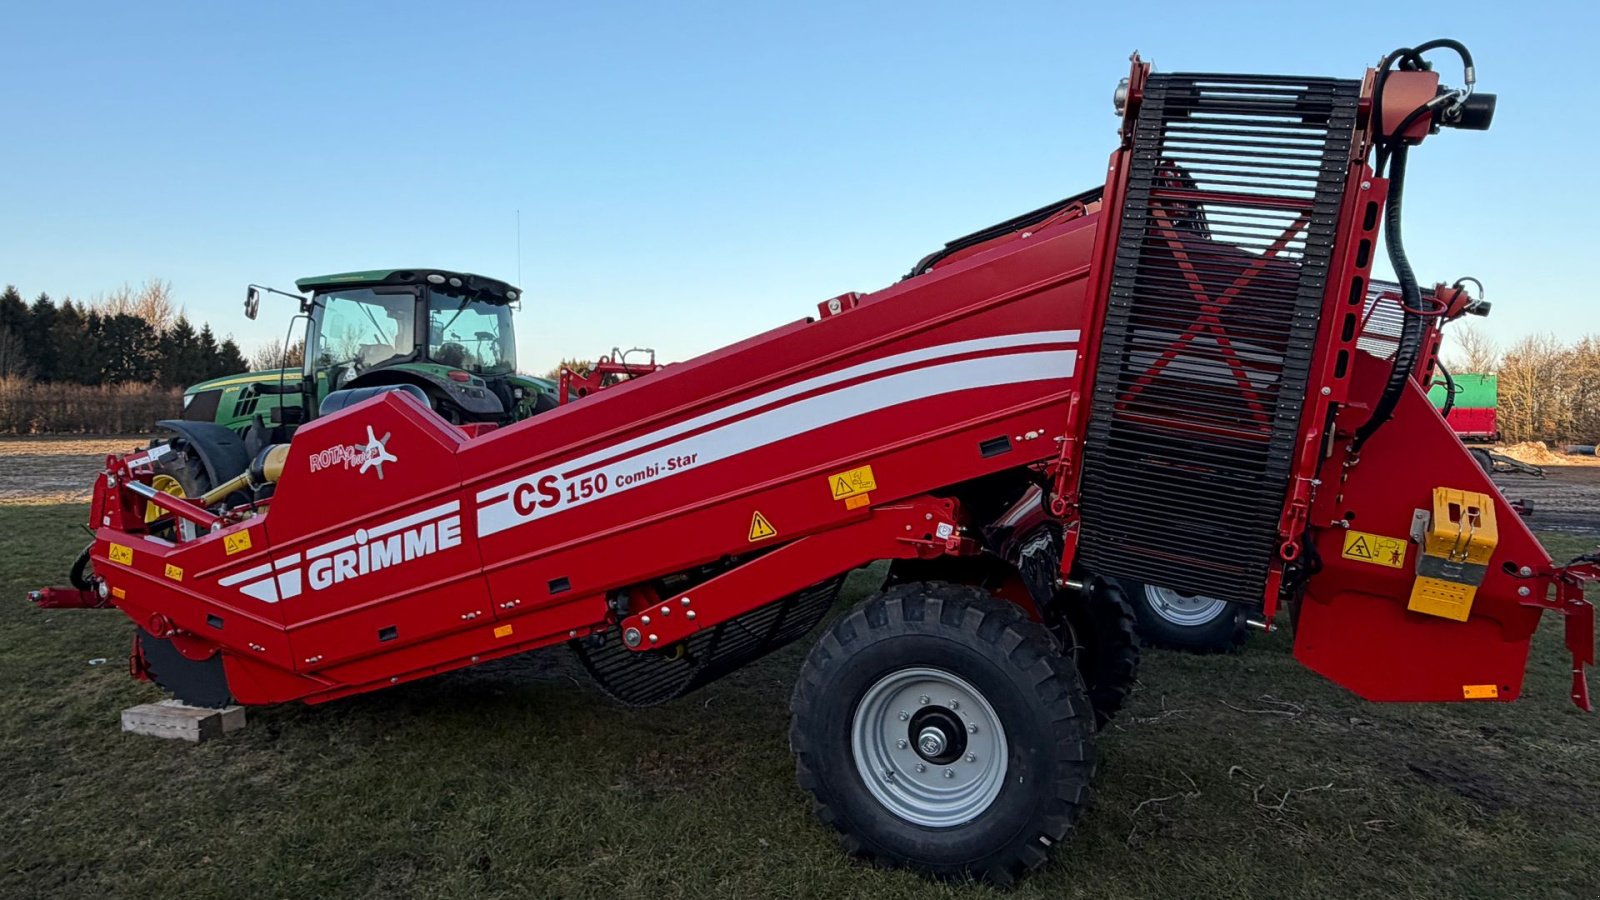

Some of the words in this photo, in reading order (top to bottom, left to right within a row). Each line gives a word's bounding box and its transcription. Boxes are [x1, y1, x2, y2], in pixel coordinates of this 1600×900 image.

[309, 444, 346, 473] ROTA
[513, 474, 561, 517] CS
[566, 473, 608, 504] 150
